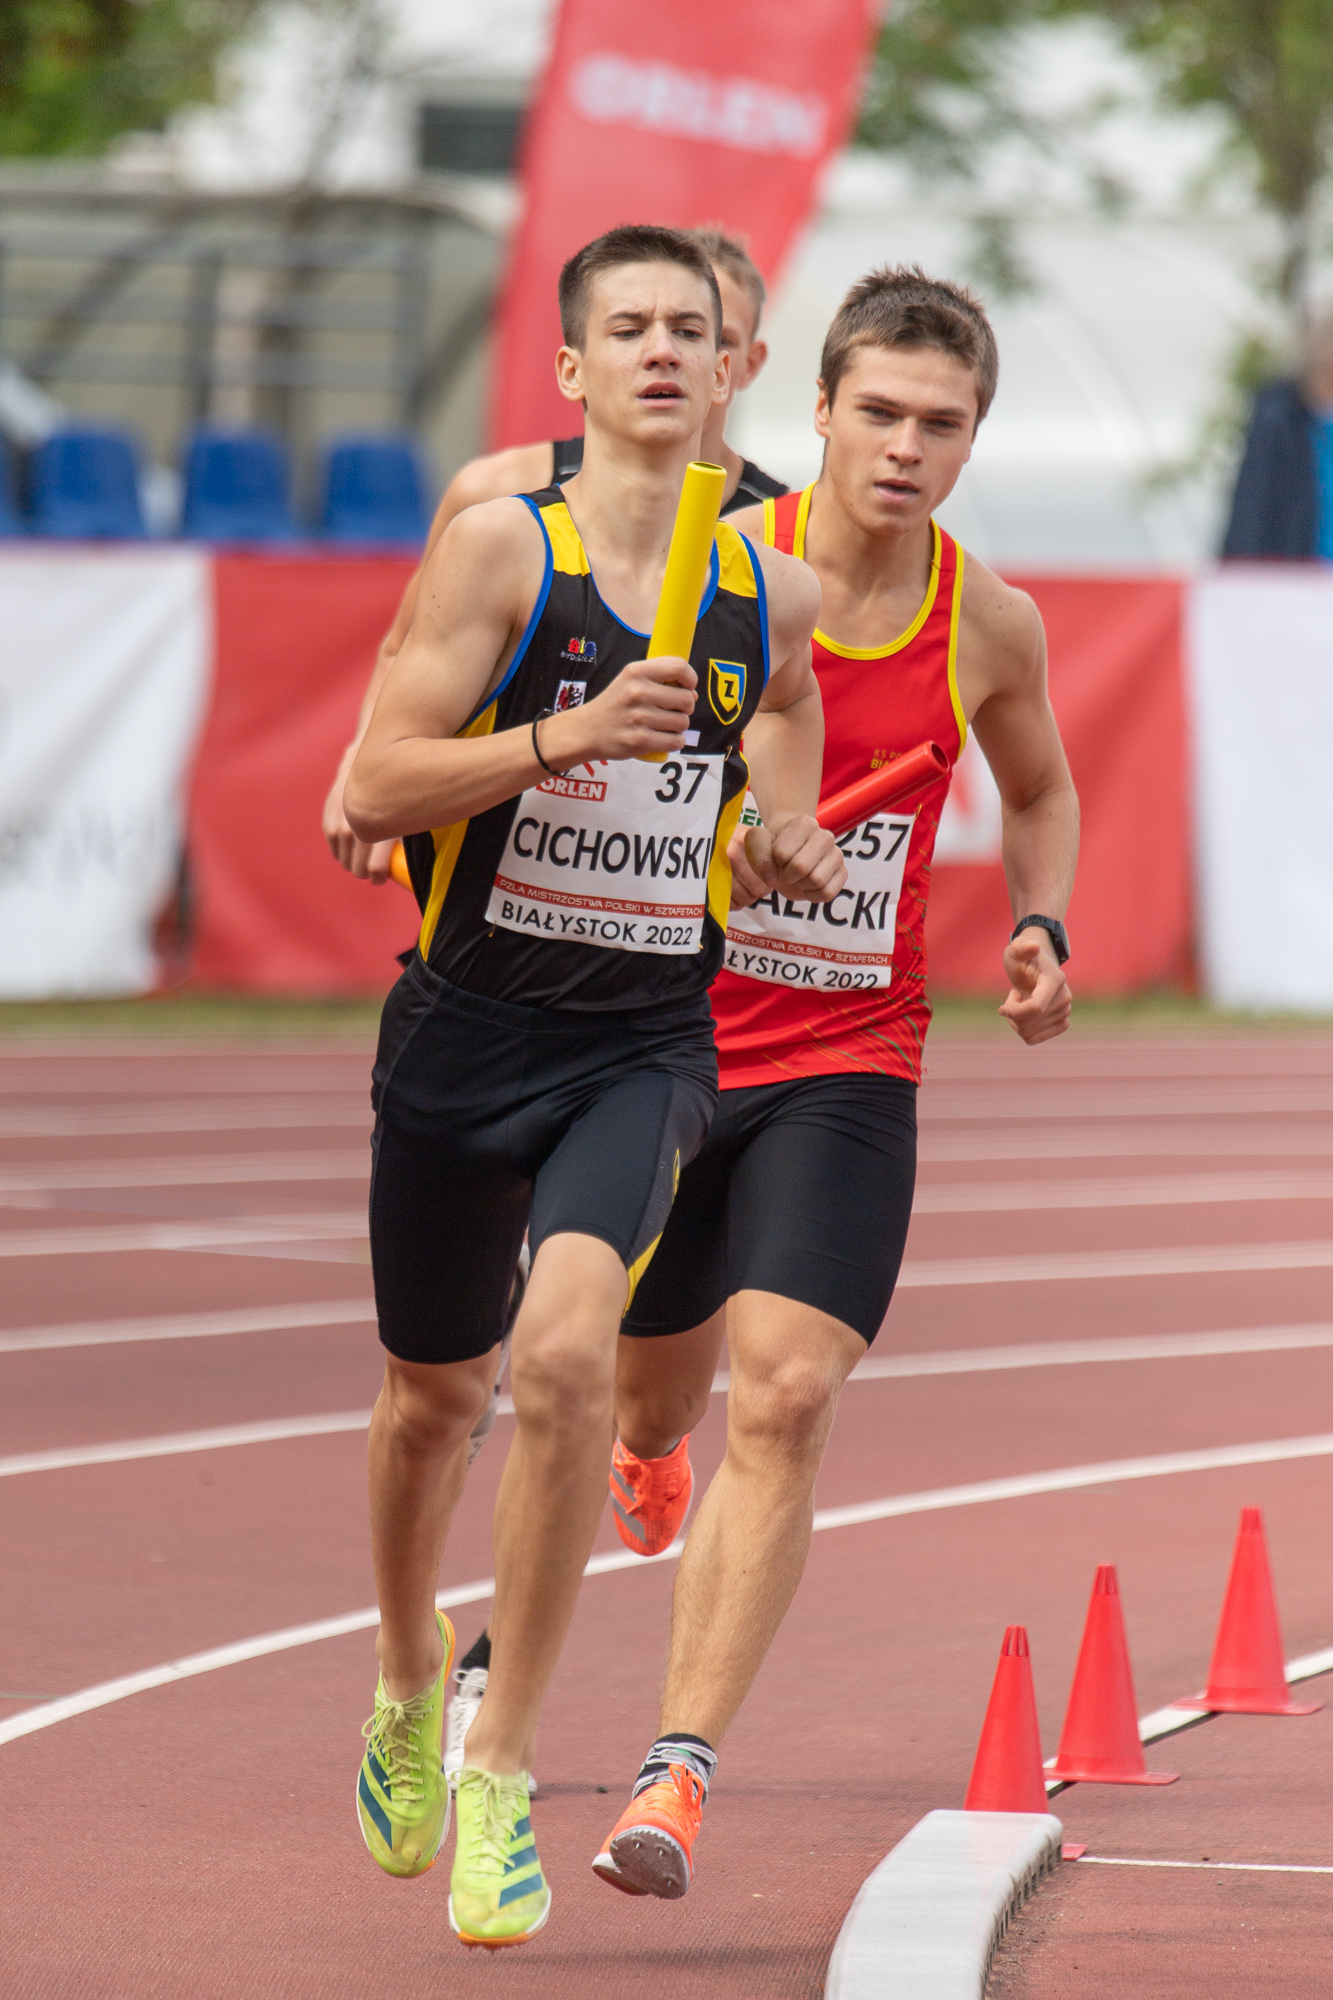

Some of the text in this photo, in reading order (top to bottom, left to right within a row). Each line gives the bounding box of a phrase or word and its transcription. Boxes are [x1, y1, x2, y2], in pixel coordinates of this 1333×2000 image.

[540, 778, 603, 799] ORLEN
[655, 761, 710, 804] 37
[513, 817, 712, 880] CICHOWSKI
[500, 879, 703, 916] PZLA MISTRZOSTWA POLSKI W SZTAFETACH
[747, 888, 891, 931] ALICKI
[501, 900, 693, 946] BIAŁYSTOK 2022
[725, 930, 888, 965] STRZOSTWA POLSKI W SZTAFETACH
[726, 950, 879, 990] ŁYSTOK 2022
